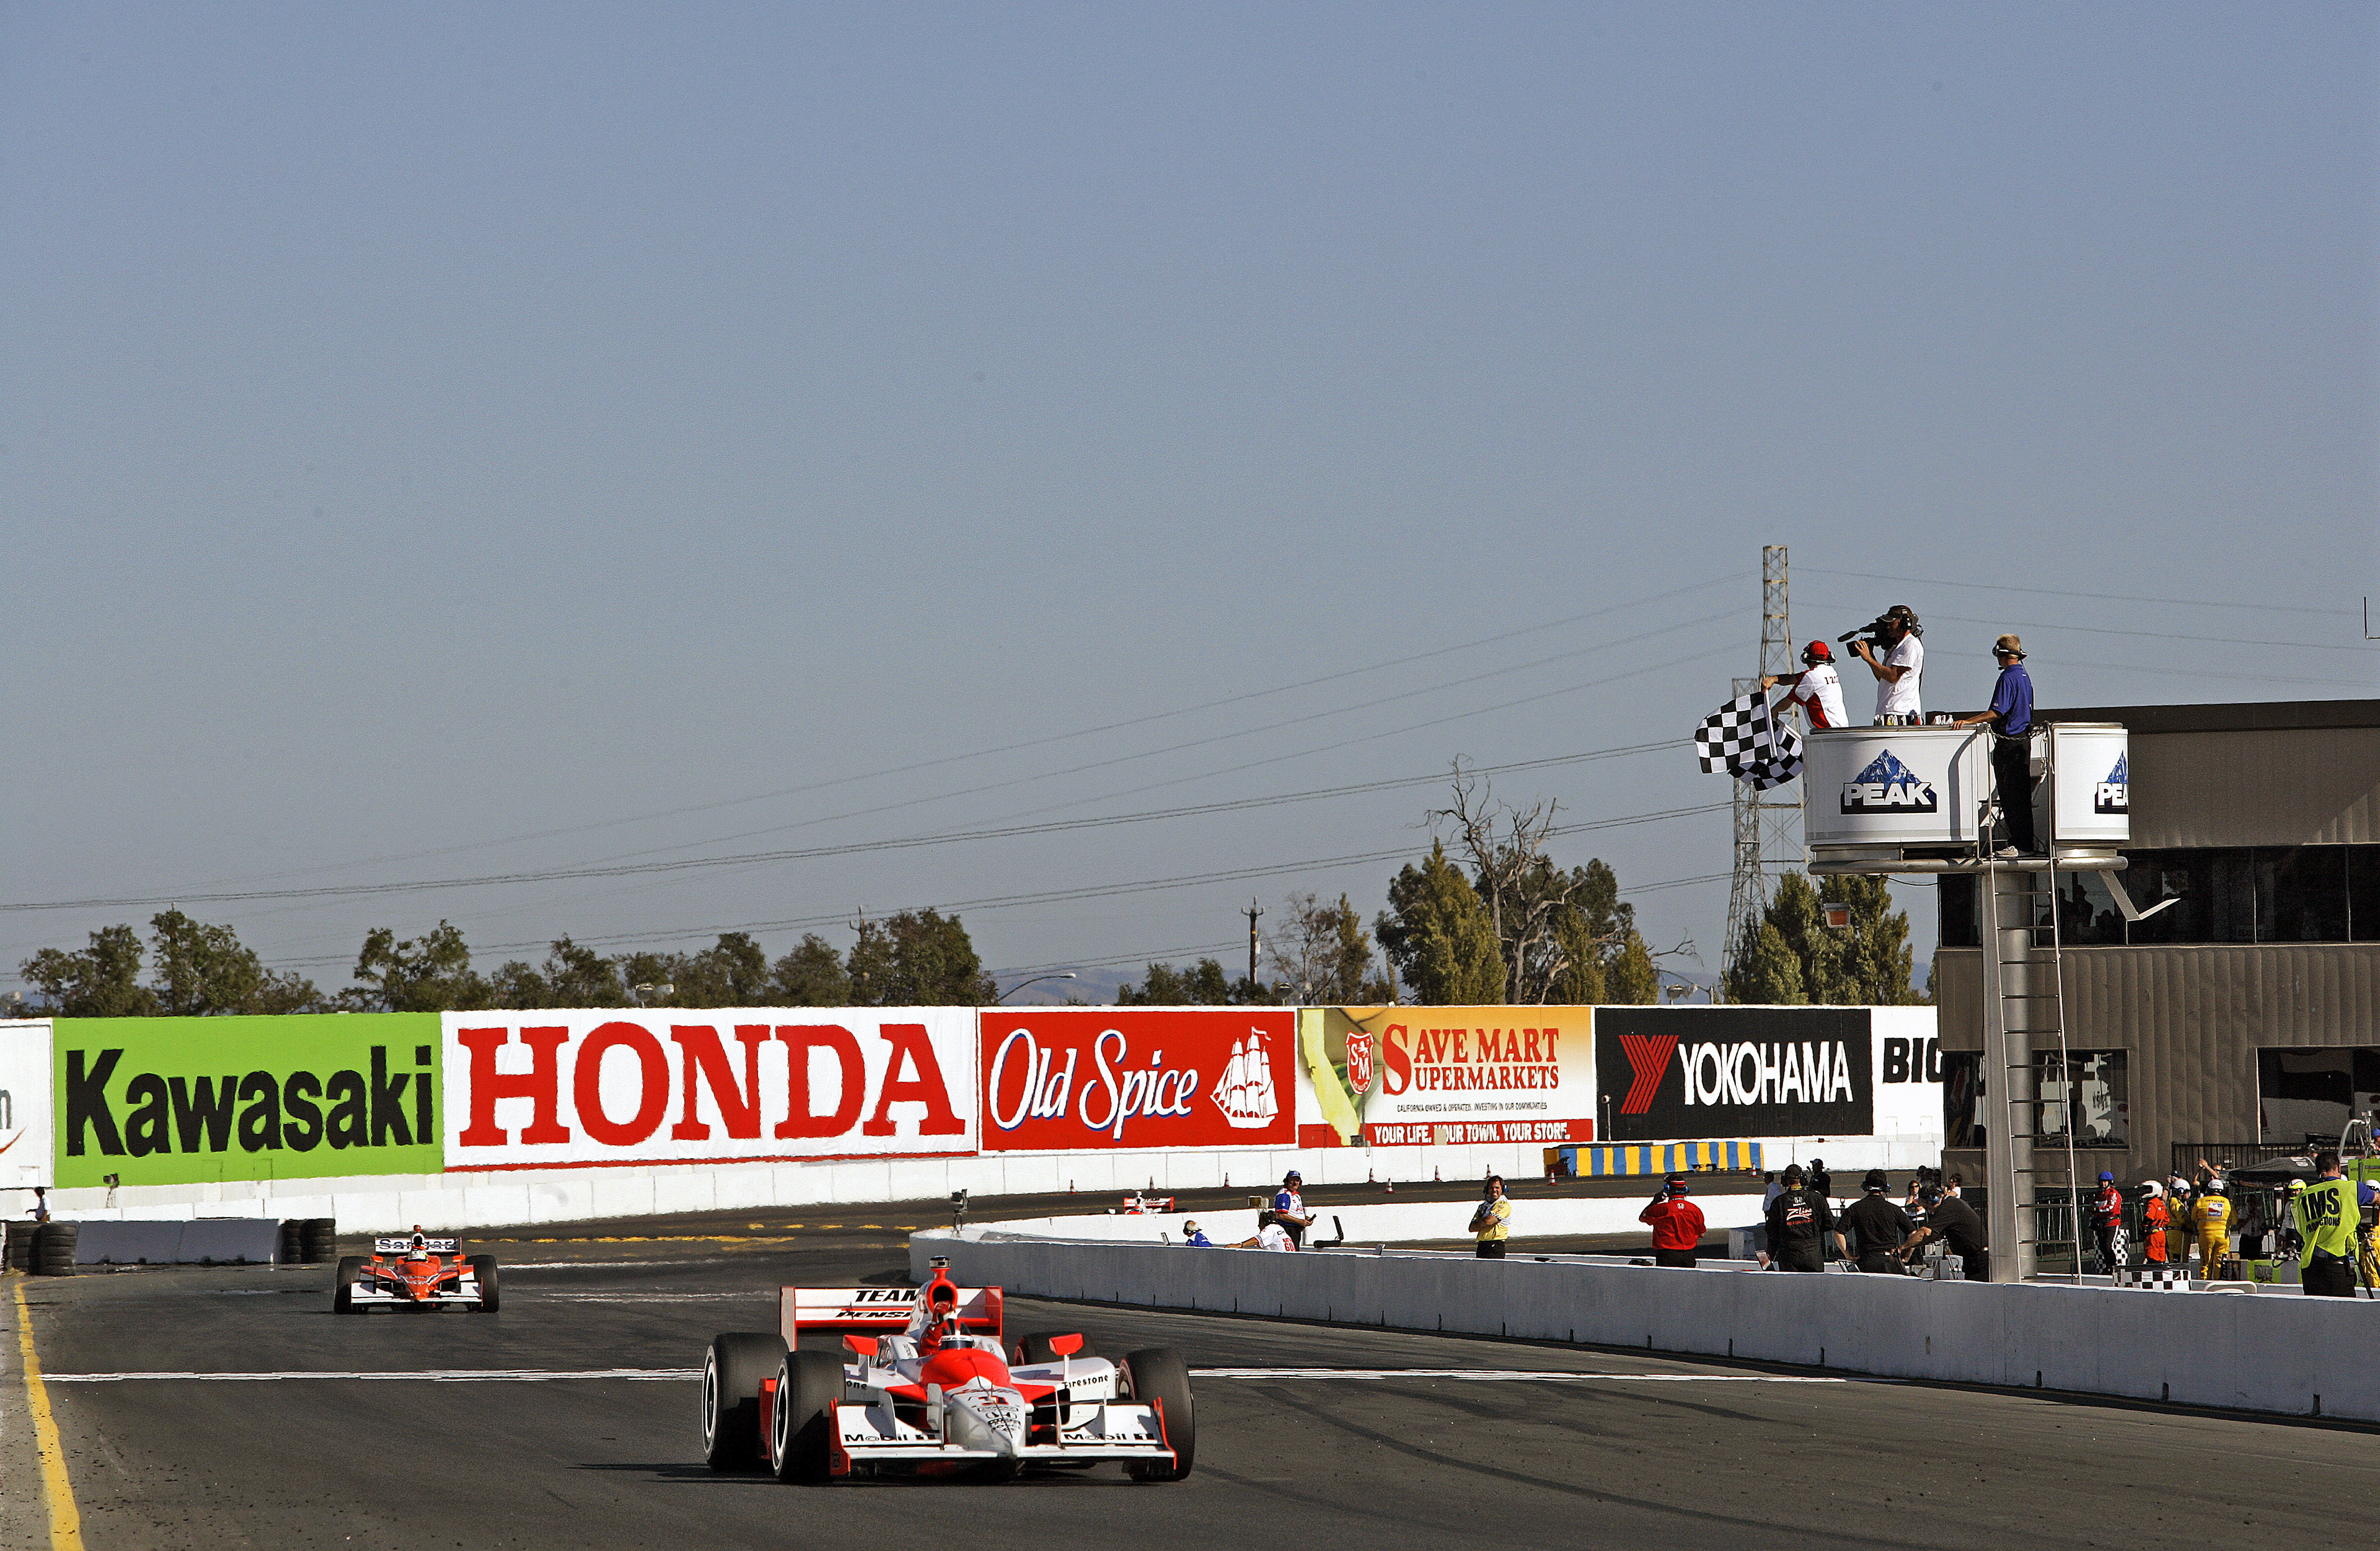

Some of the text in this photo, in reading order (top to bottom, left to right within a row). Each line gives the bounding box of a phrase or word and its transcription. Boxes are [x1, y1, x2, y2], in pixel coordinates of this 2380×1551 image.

[1844, 783, 1932, 806] PEAK
[2097, 783, 2128, 806] PEA
[1382, 1024, 1559, 1096] SAVE MART
[1678, 1041, 1853, 1105] YOKOHAMA
[457, 1022, 966, 1146] HONDA
[989, 1029, 1199, 1141] Old Spice
[66, 1045, 434, 1158] Kawasaki
[1374, 1126, 1404, 1144] YOUR
[1407, 1125, 1432, 1143] LIFE.
[1466, 1124, 1500, 1142] TOWN.
[1502, 1123, 1532, 1141] YOUR
[2301, 1188, 2340, 1222] IMS
[855, 1290, 918, 1302] TEAM
[1062, 1375, 1108, 1389] Firestone
[1064, 1433, 1127, 1441] Mobil
